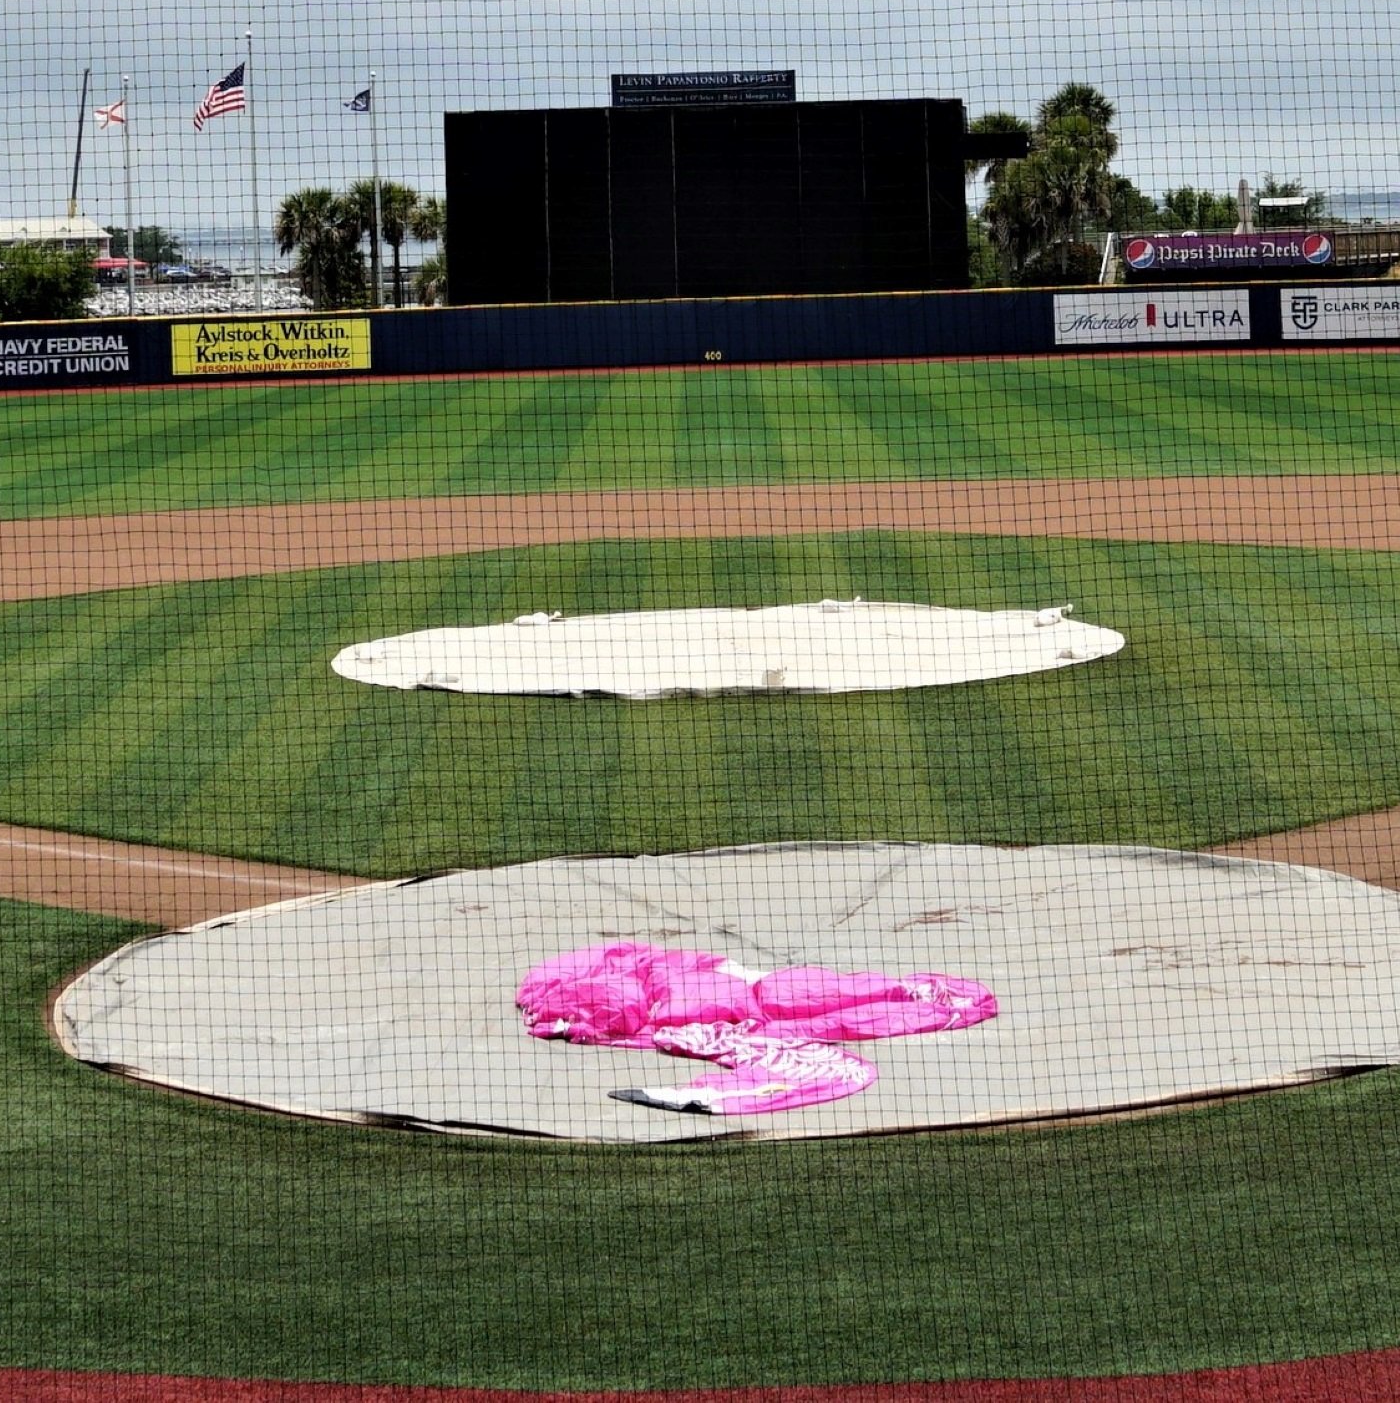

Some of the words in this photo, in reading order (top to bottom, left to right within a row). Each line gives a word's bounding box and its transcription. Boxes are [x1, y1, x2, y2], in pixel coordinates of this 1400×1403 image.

[619, 75, 652, 87] LEVIN
[657, 73, 728, 86] PAPANTONIO
[733, 73, 788, 84] RAFFERTY
[1157, 244, 1204, 263] Pepsi
[1207, 243, 1257, 262] Pirate
[1260, 241, 1301, 259] Deck
[1324, 302, 1370, 312] CLARK
[1059, 313, 1141, 333] Michelob
[1163, 309, 1244, 328] ULTRA
[196, 322, 279, 346] Aylstock,
[281, 322, 350, 340] Witkin,
[47, 335, 128, 353] FEDERAL
[196, 346, 243, 363] Kreis
[247, 352, 260, 362] &
[263, 343, 350, 361] Overholtz
[66, 355, 129, 373] UNION
[704, 350, 722, 360] 400
[195, 363, 250, 373] PERSONAL
[252, 361, 287, 372] INJURY
[291, 360, 351, 370] ATTORNEYS
